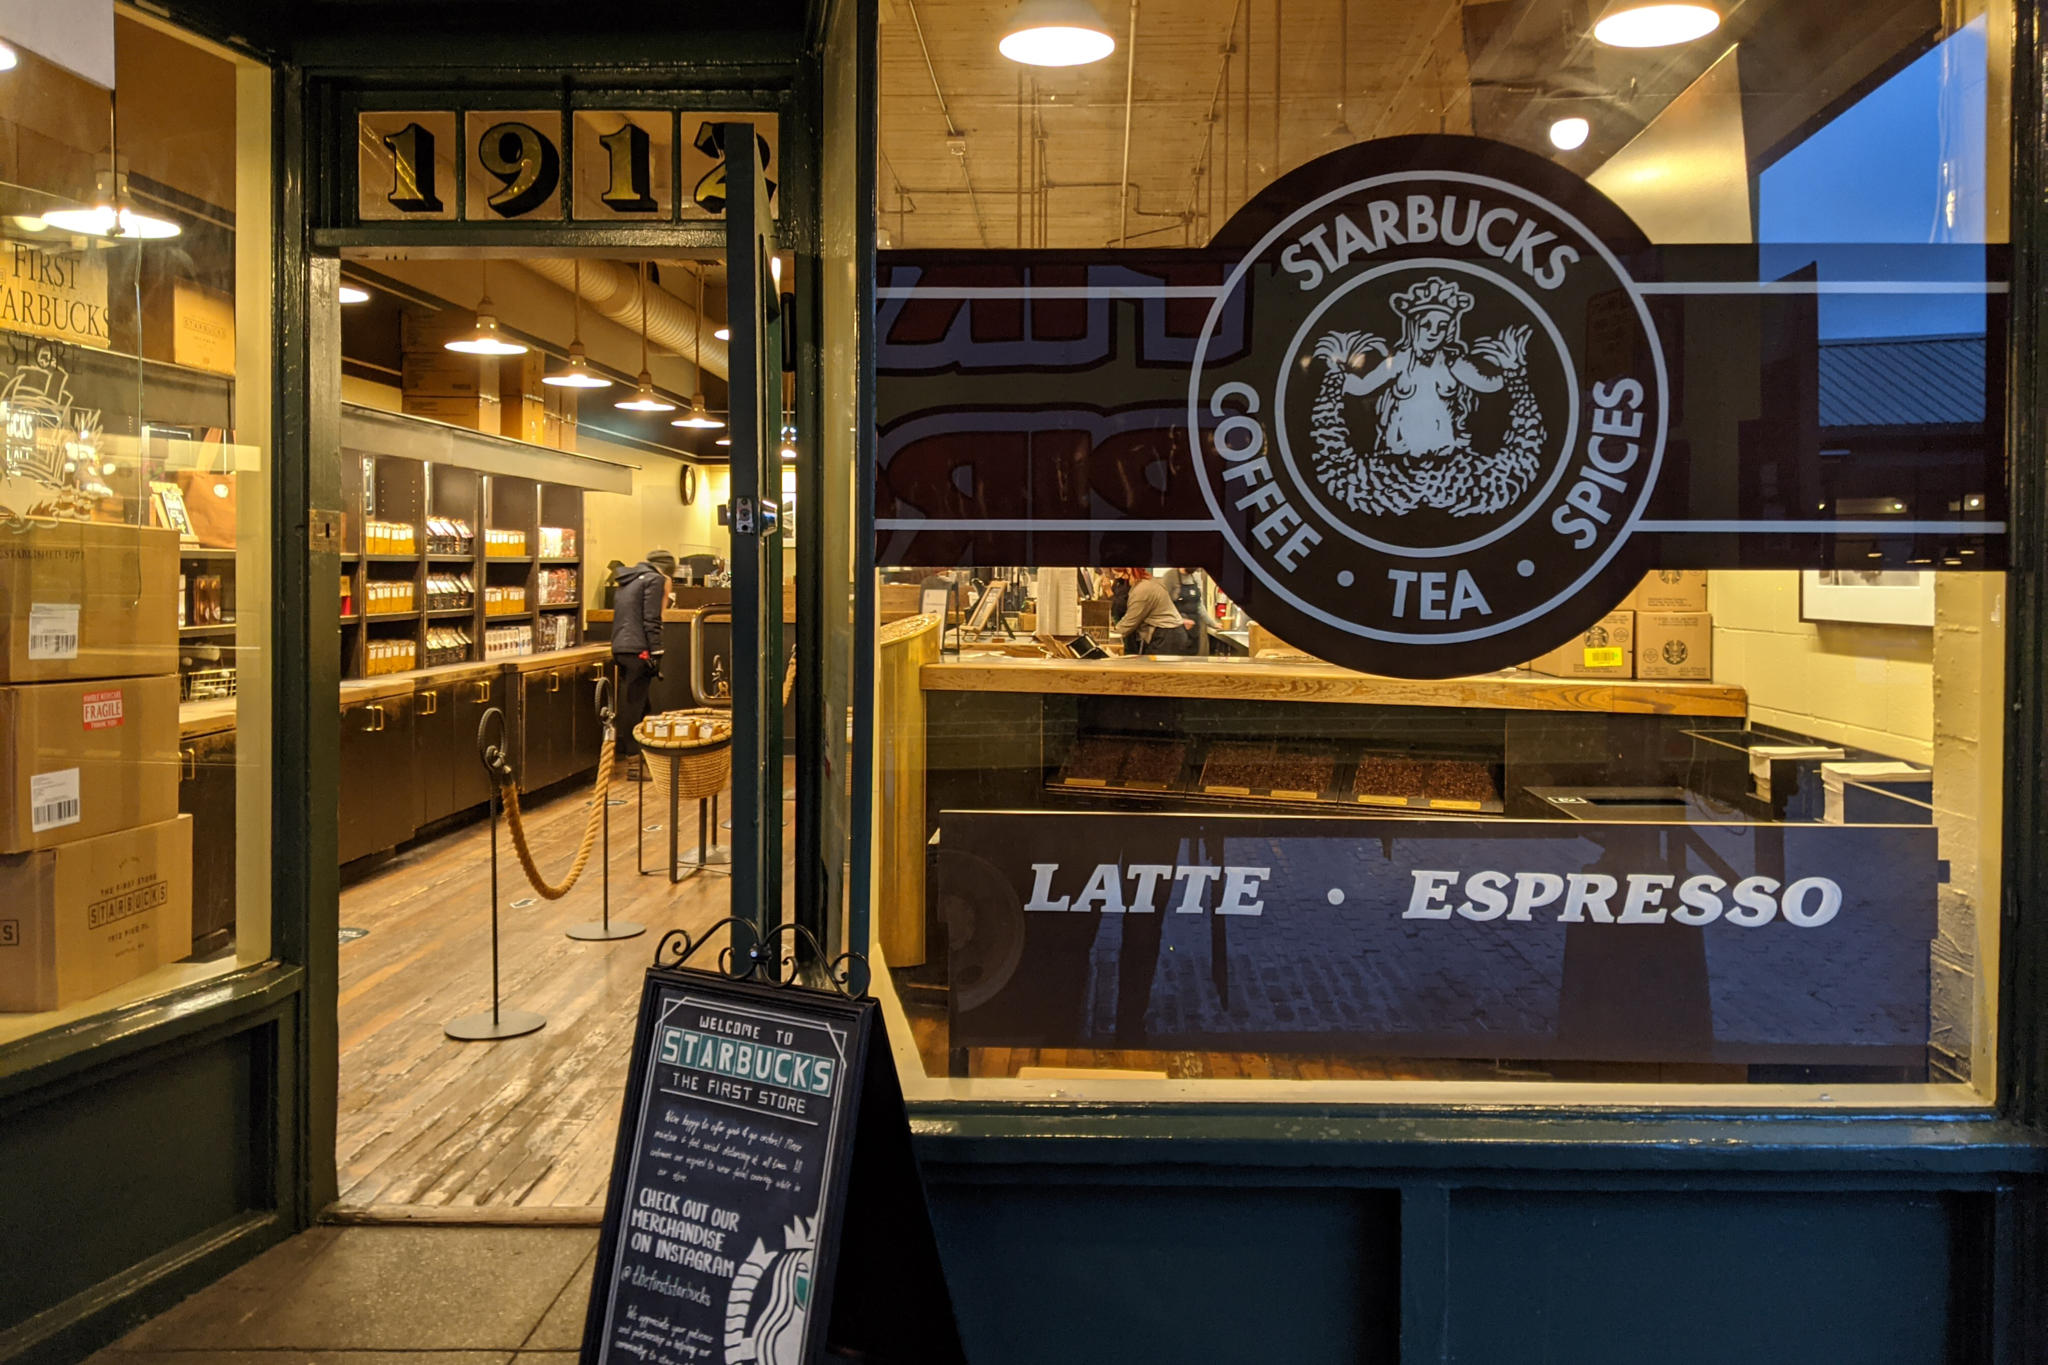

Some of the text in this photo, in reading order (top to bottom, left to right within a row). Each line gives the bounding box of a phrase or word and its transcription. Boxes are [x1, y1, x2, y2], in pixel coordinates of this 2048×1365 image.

[384, 122, 777, 218] 1912
[1281, 195, 1580, 291] STARBUCKS
[12, 243, 80, 290] FIRST
[0, 284, 110, 339] ARBUCKS
[6, 329, 83, 375] STORE
[1209, 381, 1323, 573] COFFEE
[1550, 376, 1645, 550] SPICES
[64, 550, 85, 563] 1971
[1388, 568, 1493, 620] TEA
[85, 701, 121, 720] FRAGILE
[90, 885, 166, 924] STARBUCKS
[100, 873, 157, 897] THE FIRST STORE
[1022, 863, 1844, 929] LATTE ESPRESSO
[699, 1015, 794, 1045] WELCOME TO
[661, 1030, 832, 1092] STARBUCKS
[673, 1072, 807, 1114] THE FIRST STORE
[701, 1118, 710, 1130] to
[631, 1209, 726, 1252] MERCHANDISE
[640, 1187, 740, 1232] CHECK OUT OUR
[631, 1232, 736, 1278] ON INSTAGRAM
